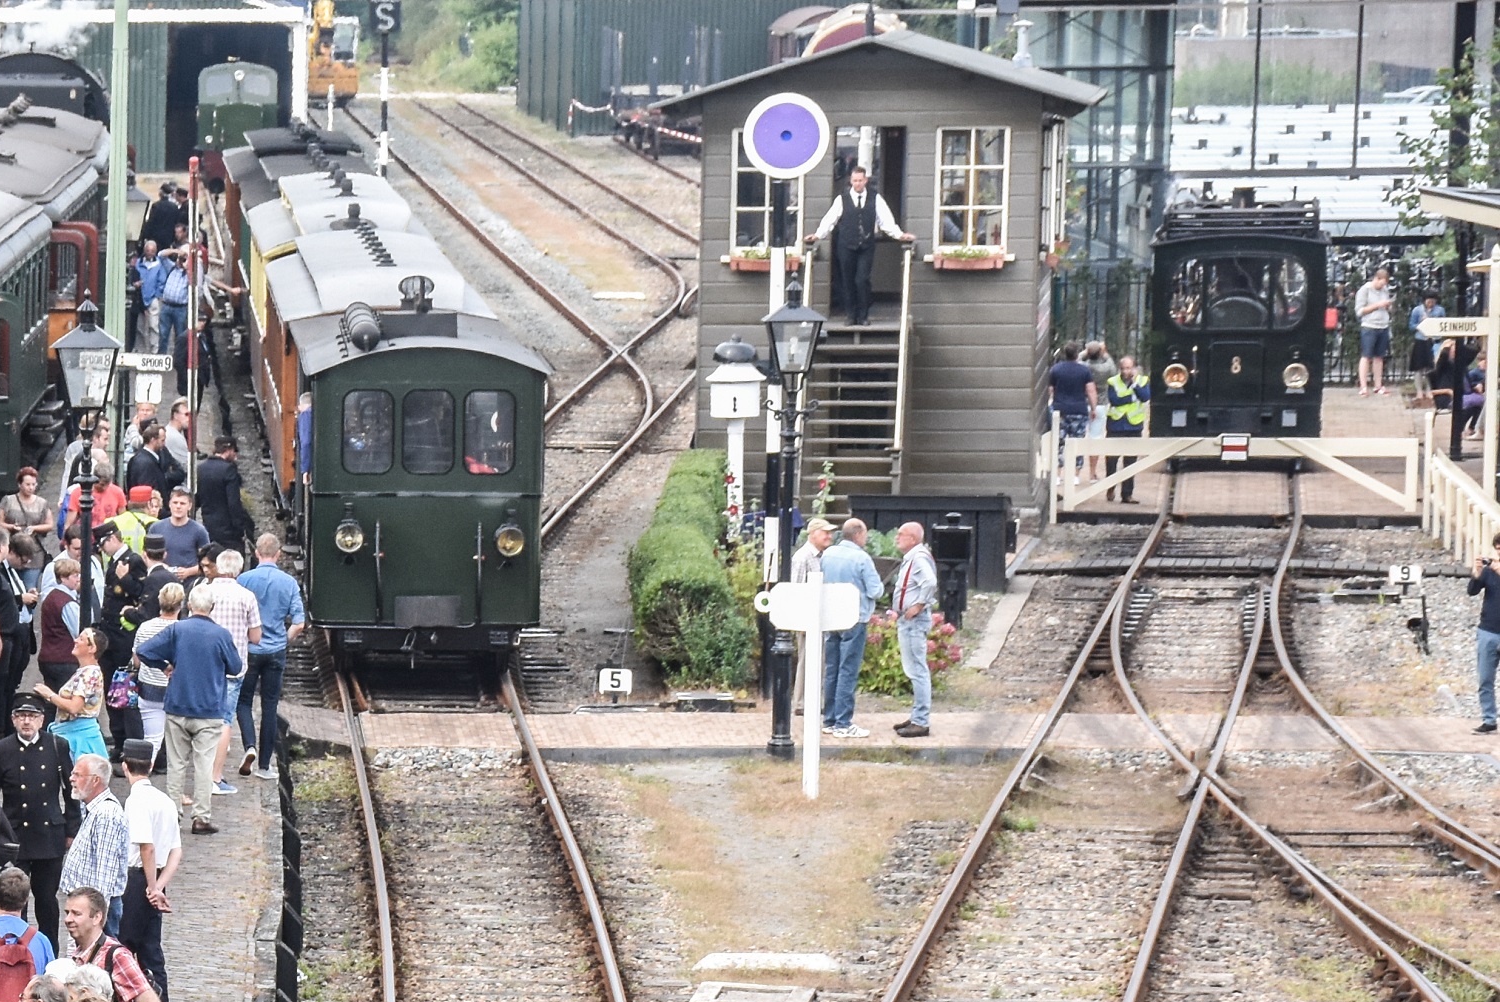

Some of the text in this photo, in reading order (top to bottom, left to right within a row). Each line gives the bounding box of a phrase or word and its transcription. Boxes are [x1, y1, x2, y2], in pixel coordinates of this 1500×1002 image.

[376, 3, 395, 30] S
[1440, 321, 1477, 332] SEINHUIS
[104, 354, 111, 367] 8
[141, 356, 172, 371] SPOOR 9
[1231, 356, 1241, 374] 8
[1401, 565, 1410, 581] 9
[610, 670, 621, 689] 5
